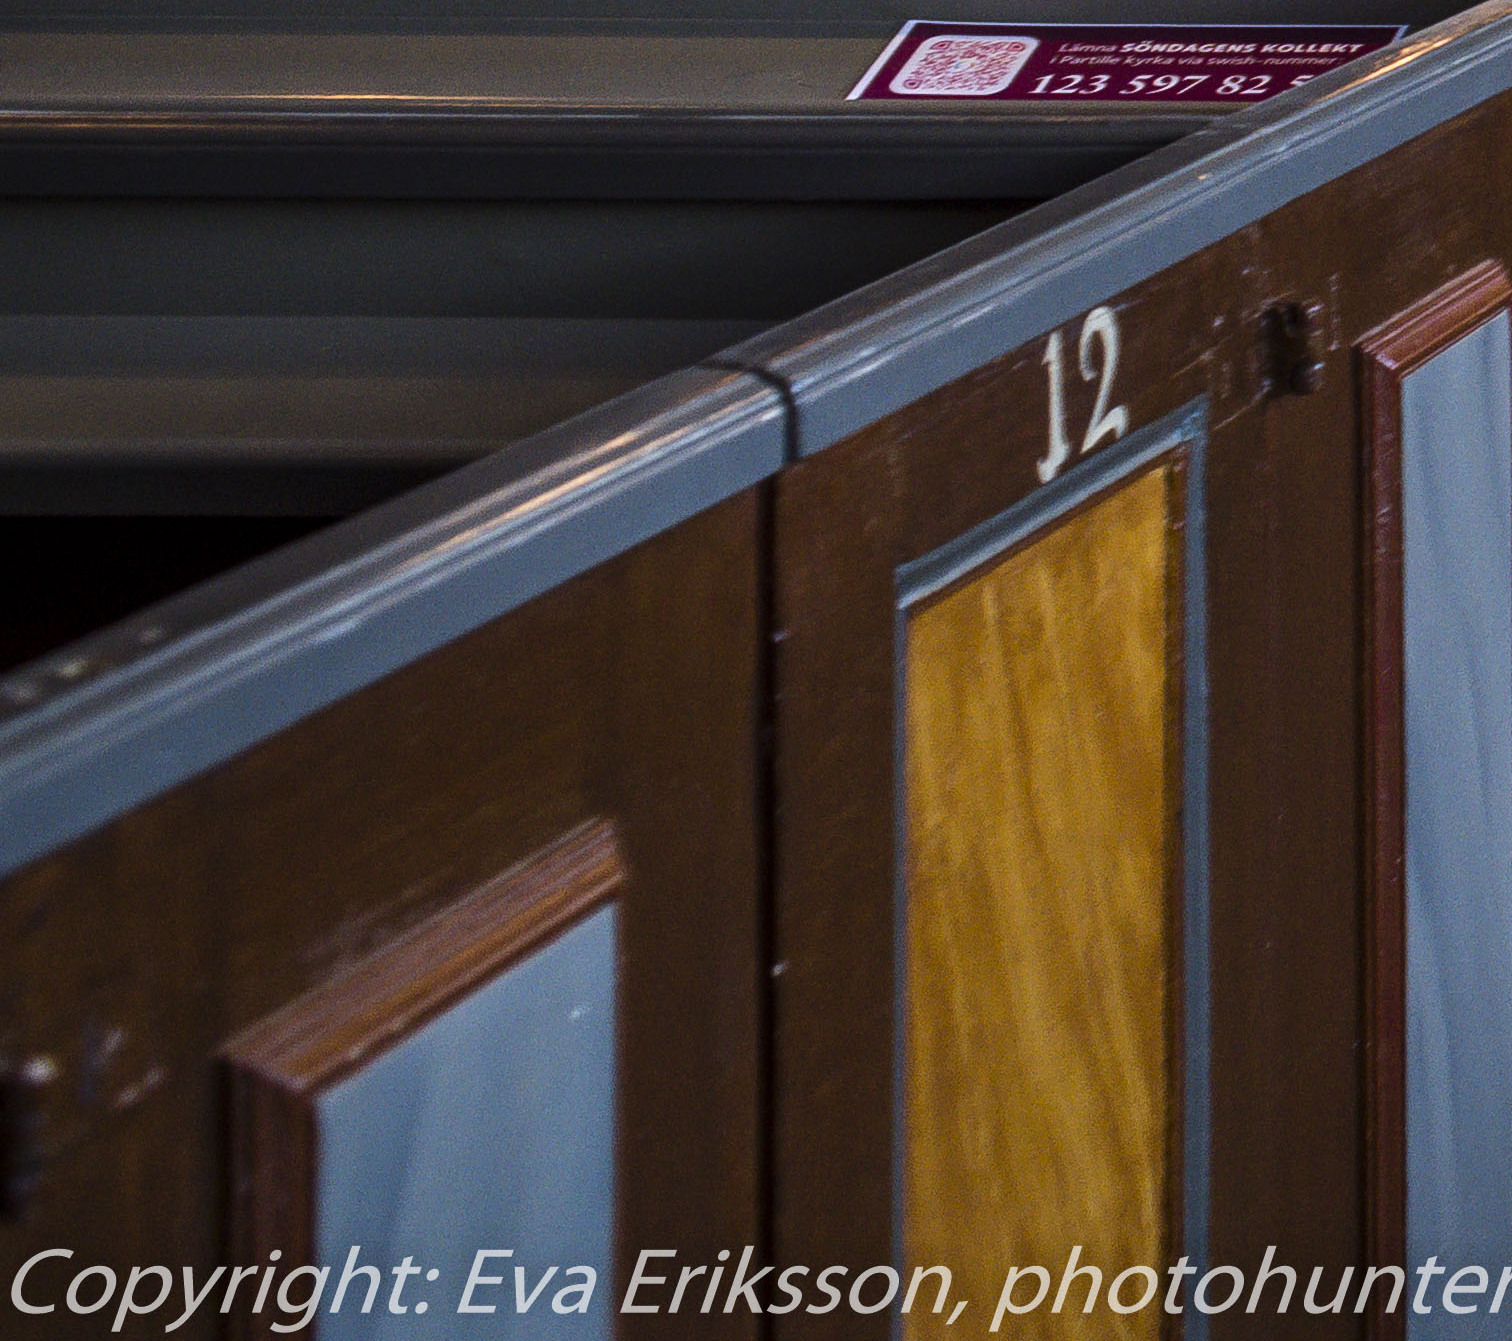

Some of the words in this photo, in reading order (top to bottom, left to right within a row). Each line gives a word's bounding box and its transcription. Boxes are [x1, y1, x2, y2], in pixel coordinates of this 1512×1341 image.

[1120, 39, 1254, 53] SÖNDAGENS
[1261, 43, 1365, 53] KOLLEKT
[1058, 55, 1119, 65] Partille
[1120, 56, 1173, 67] kyrka
[1178, 56, 1201, 65] via
[1028, 74, 1112, 94] 123
[1119, 74, 1211, 94] 597
[1215, 74, 1273, 94] 82
[1036, 305, 1129, 483] 12
